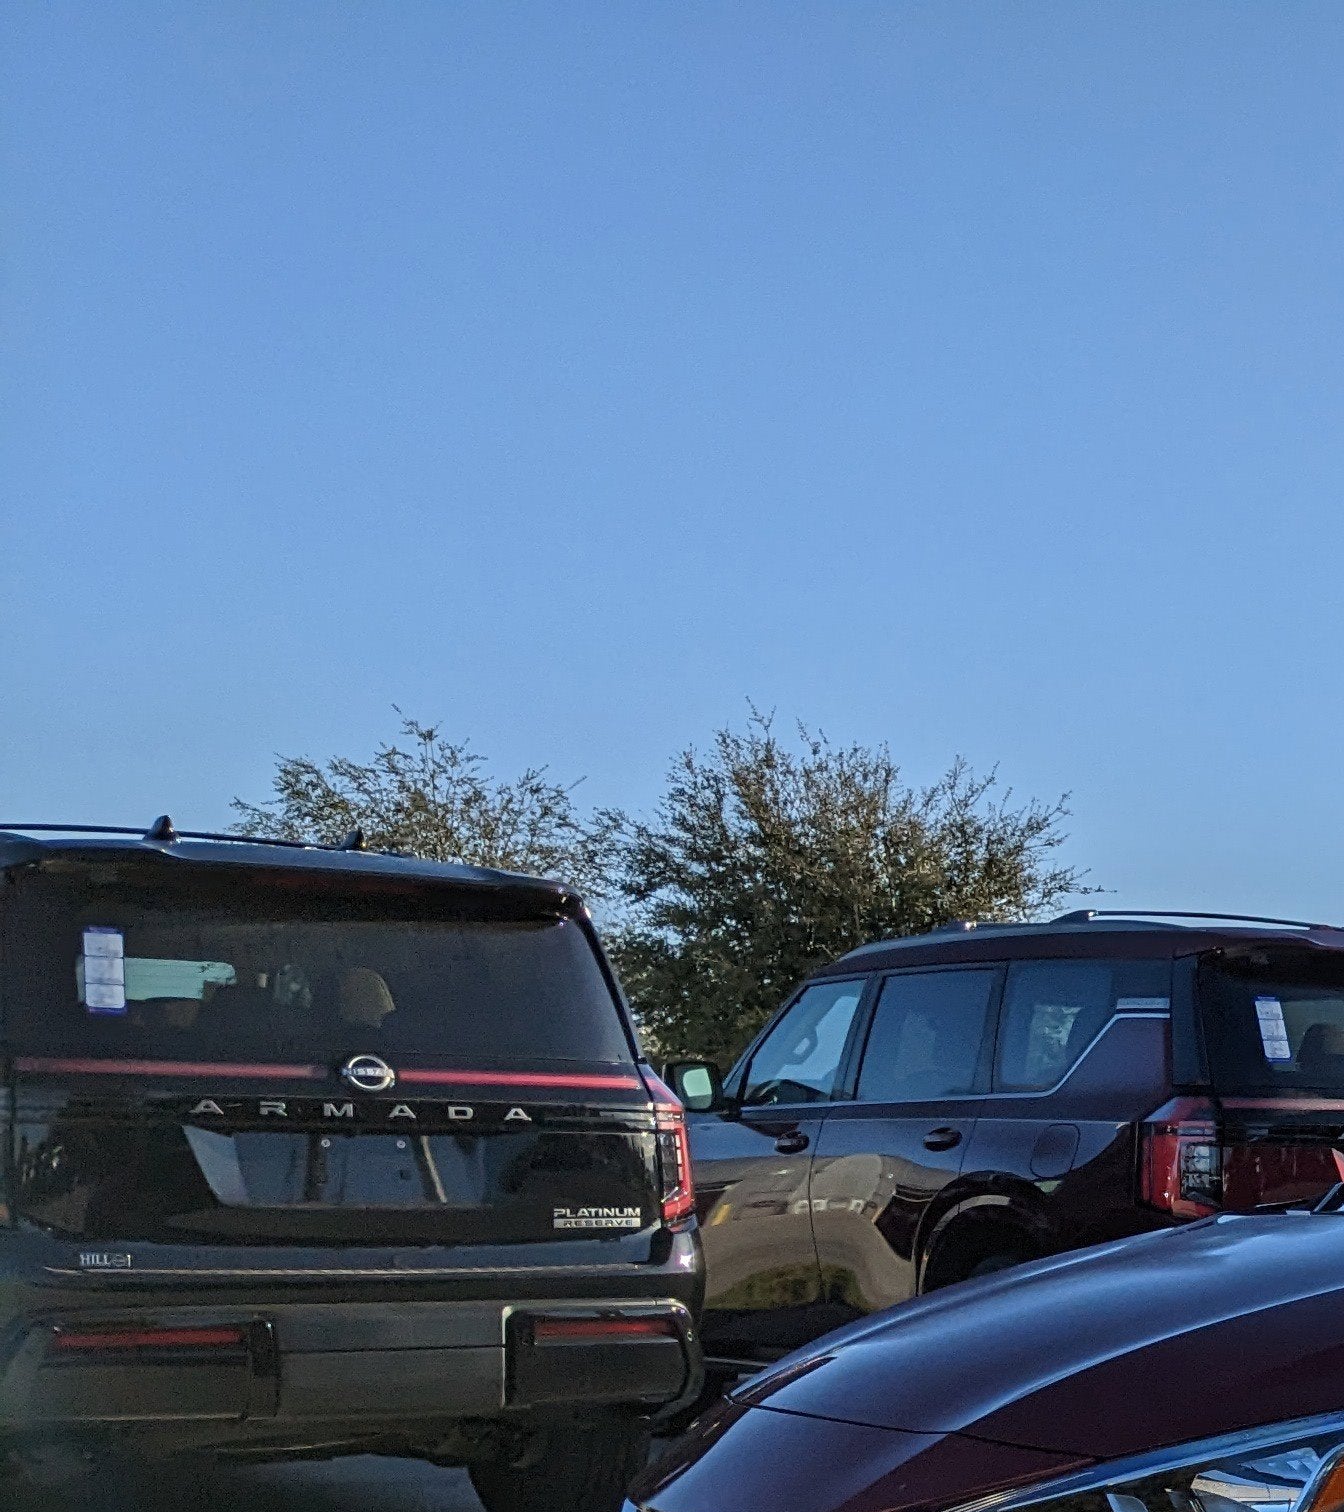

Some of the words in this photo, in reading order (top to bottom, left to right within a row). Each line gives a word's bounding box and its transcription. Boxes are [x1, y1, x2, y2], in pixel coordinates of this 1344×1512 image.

[189, 1100, 533, 1122] ARMADA
[553, 1207, 641, 1218] PLATINUM
[563, 1219, 633, 1228] RESERVE
[80, 1254, 111, 1266] HILL
